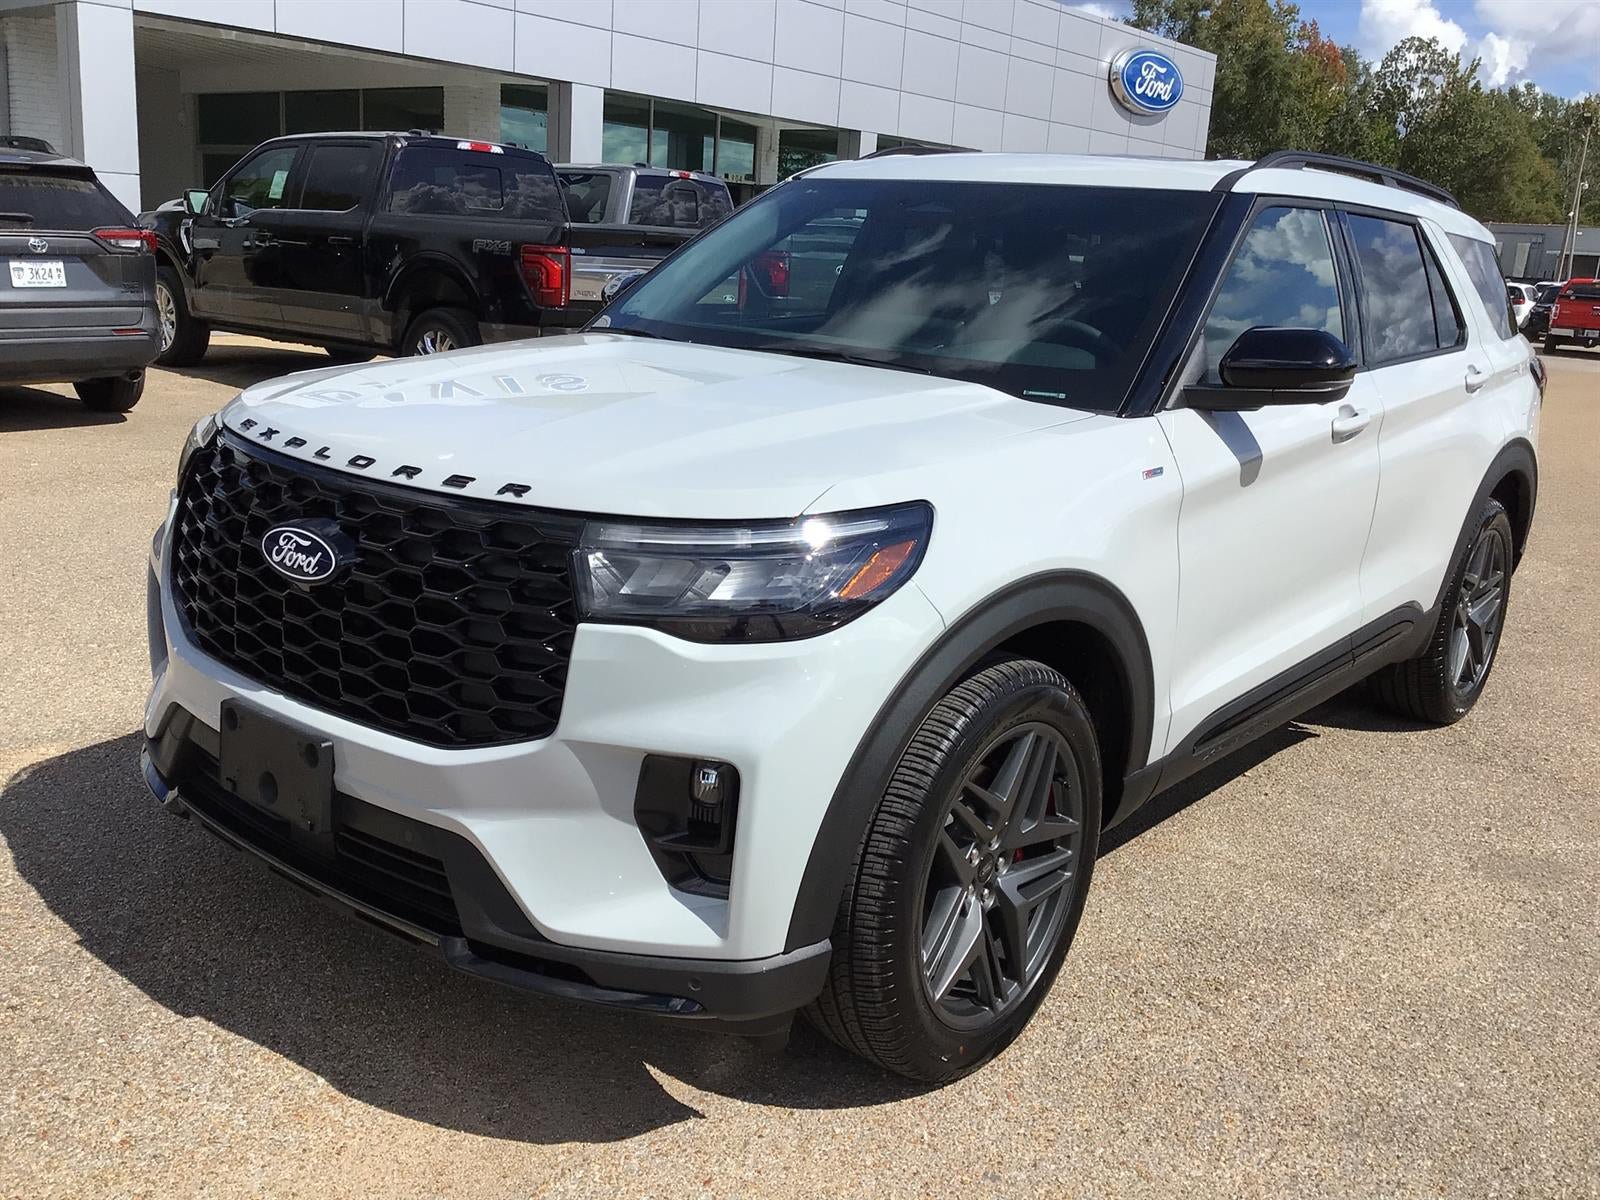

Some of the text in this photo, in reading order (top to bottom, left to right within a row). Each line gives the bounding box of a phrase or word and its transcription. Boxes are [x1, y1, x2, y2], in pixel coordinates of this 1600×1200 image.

[1135, 60, 1175, 102] Ford
[472, 239, 511, 253] FX4
[28, 267, 53, 280] 3K24
[238, 417, 533, 499] EXPLORER
[271, 531, 322, 576] Ford
